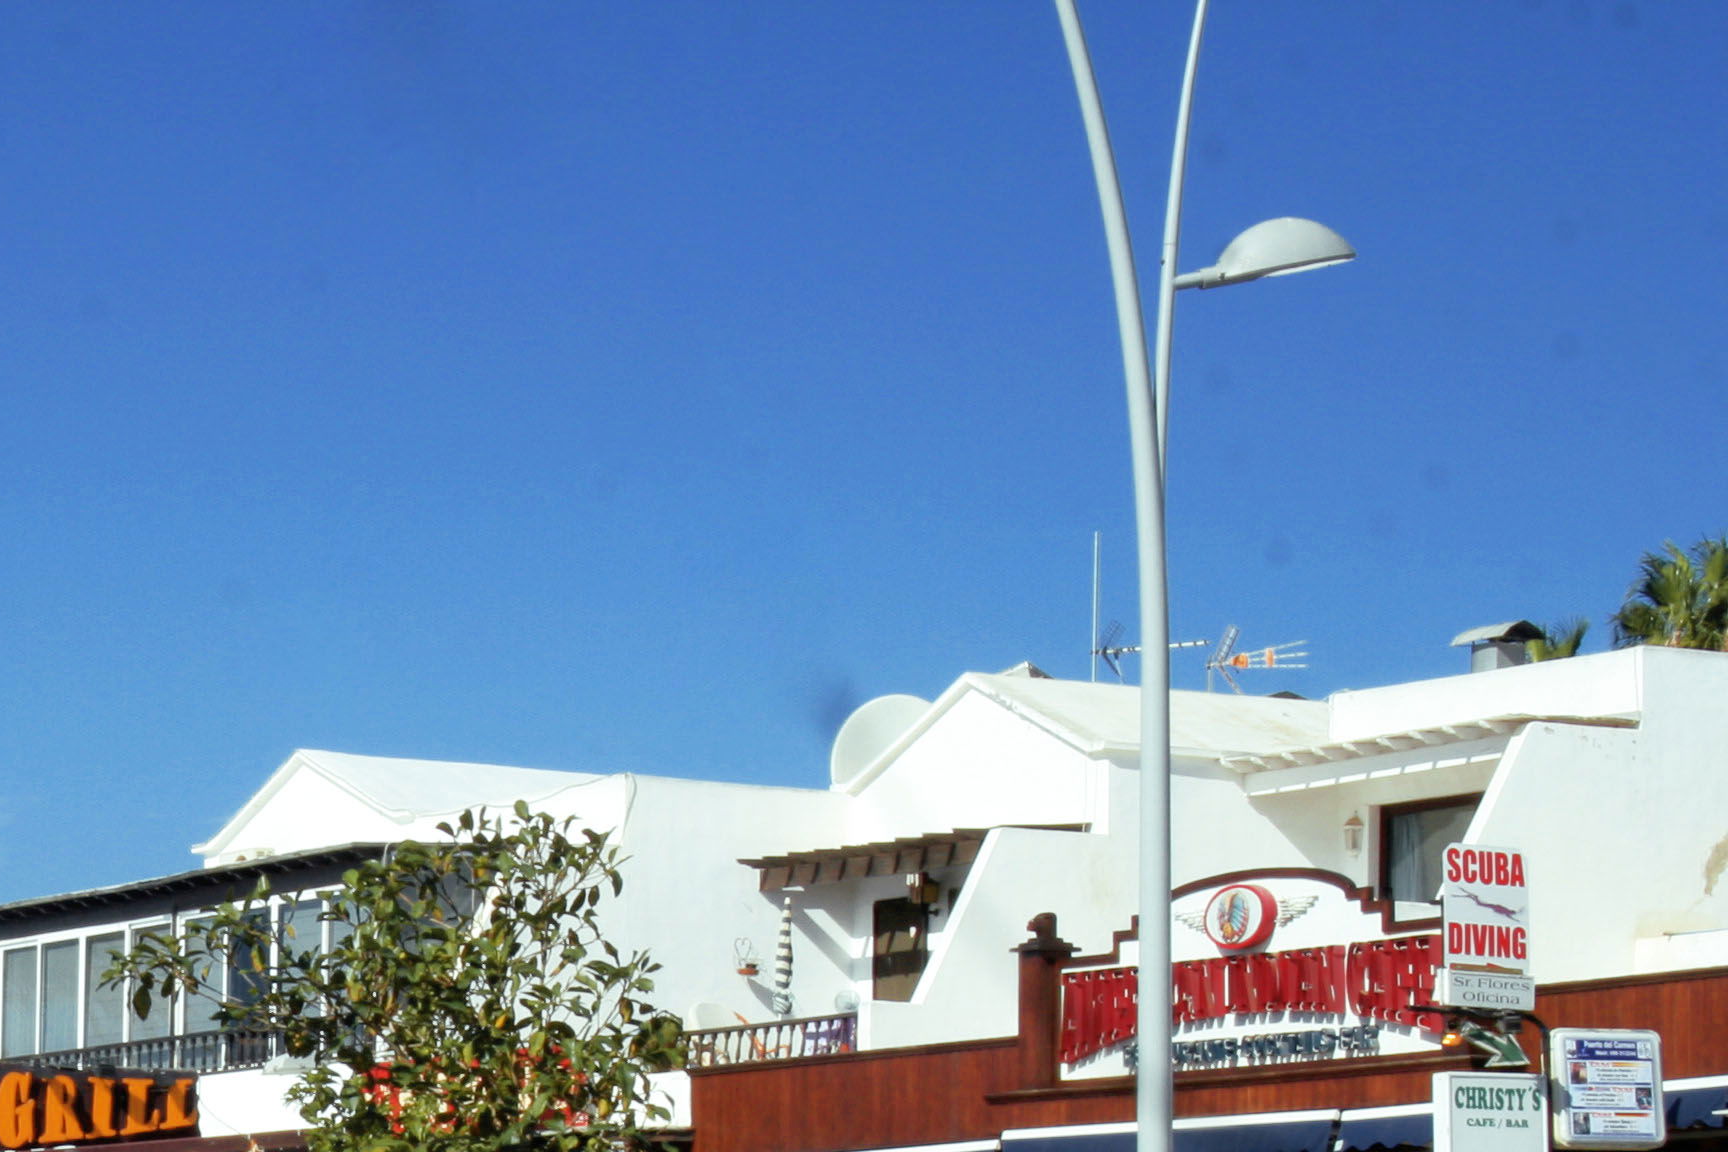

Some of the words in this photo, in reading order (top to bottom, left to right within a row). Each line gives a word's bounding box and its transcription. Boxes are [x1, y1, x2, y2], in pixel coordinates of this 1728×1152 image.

[1446, 848, 1525, 887] SCUBA
[1448, 921, 1527, 960] DIVING
[1478, 977, 1531, 993] Flores
[1462, 991, 1521, 1005] Oficina
[1466, 1118, 1496, 1127] CAFE
[1505, 1119, 1530, 1128] BAR
